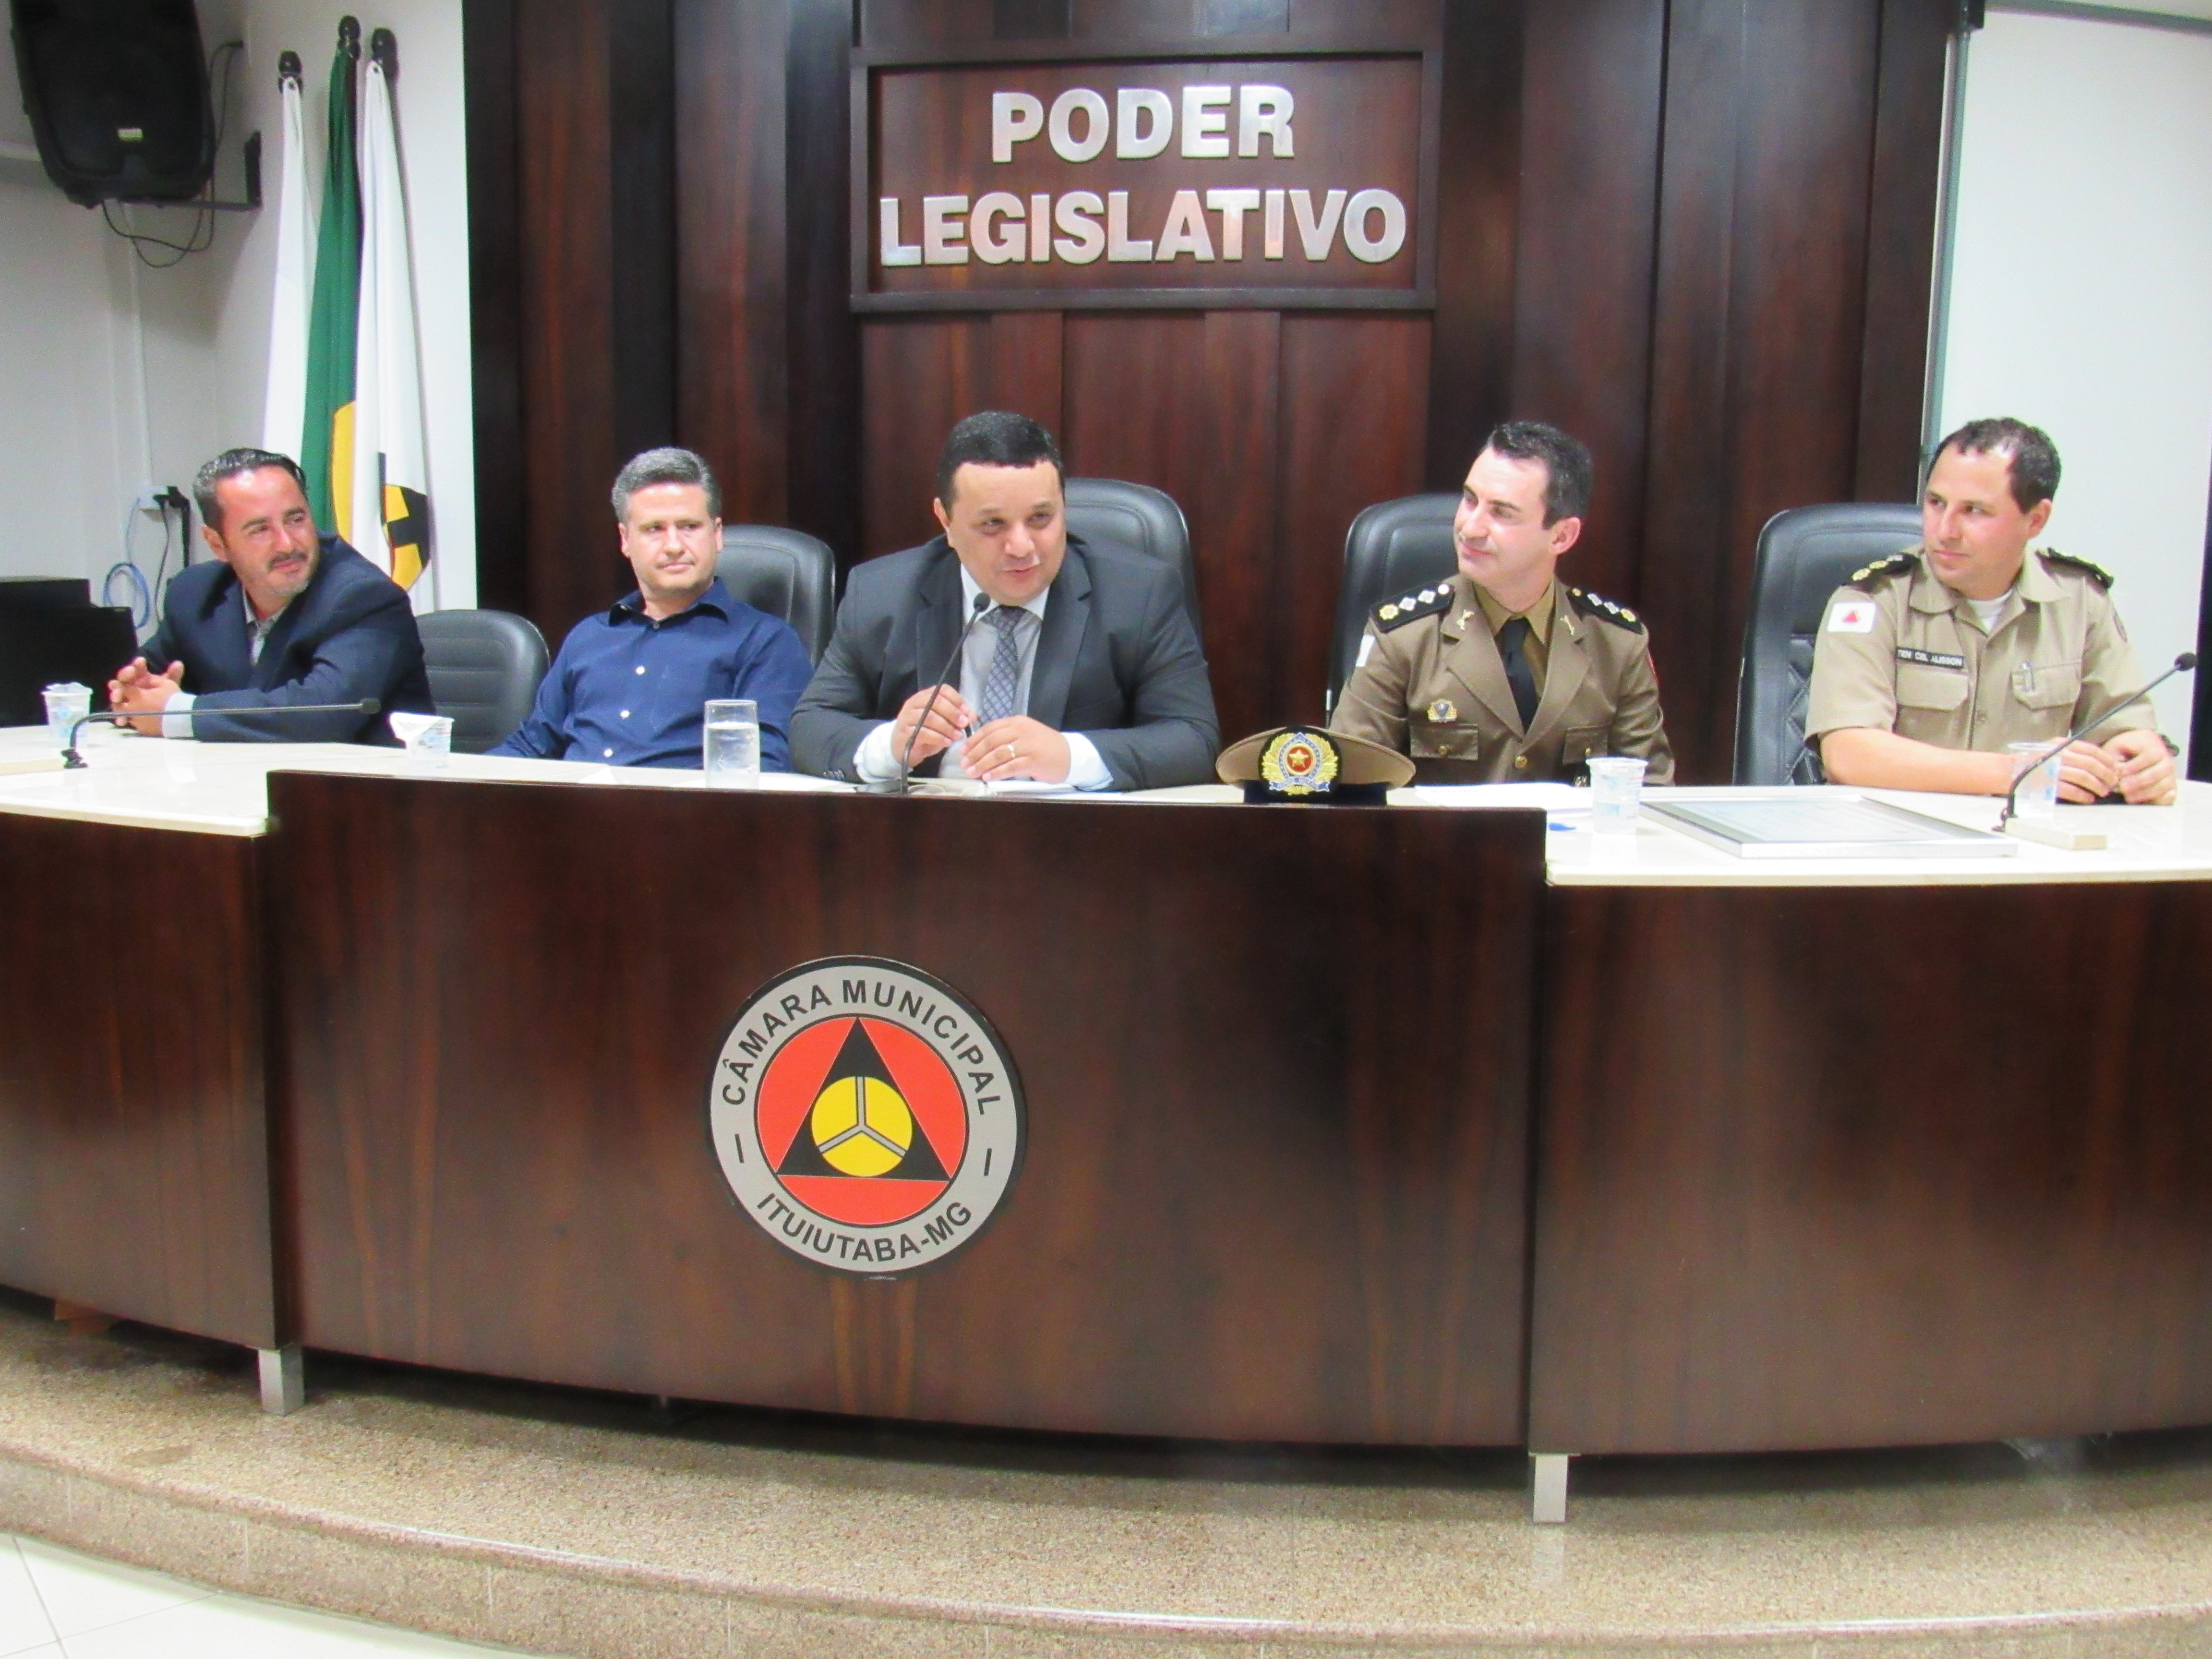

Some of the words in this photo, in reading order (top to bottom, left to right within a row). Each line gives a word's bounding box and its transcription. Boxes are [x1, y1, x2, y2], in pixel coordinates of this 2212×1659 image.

[992, 84, 1295, 163] PODER
[880, 189, 1407, 266] LEGISLATIVO
[722, 985, 832, 1105] CÂMARA
[842, 979, 1001, 1115] MUNICIPAL
[757, 1192, 972, 1262] ITUIUTABA-MG
